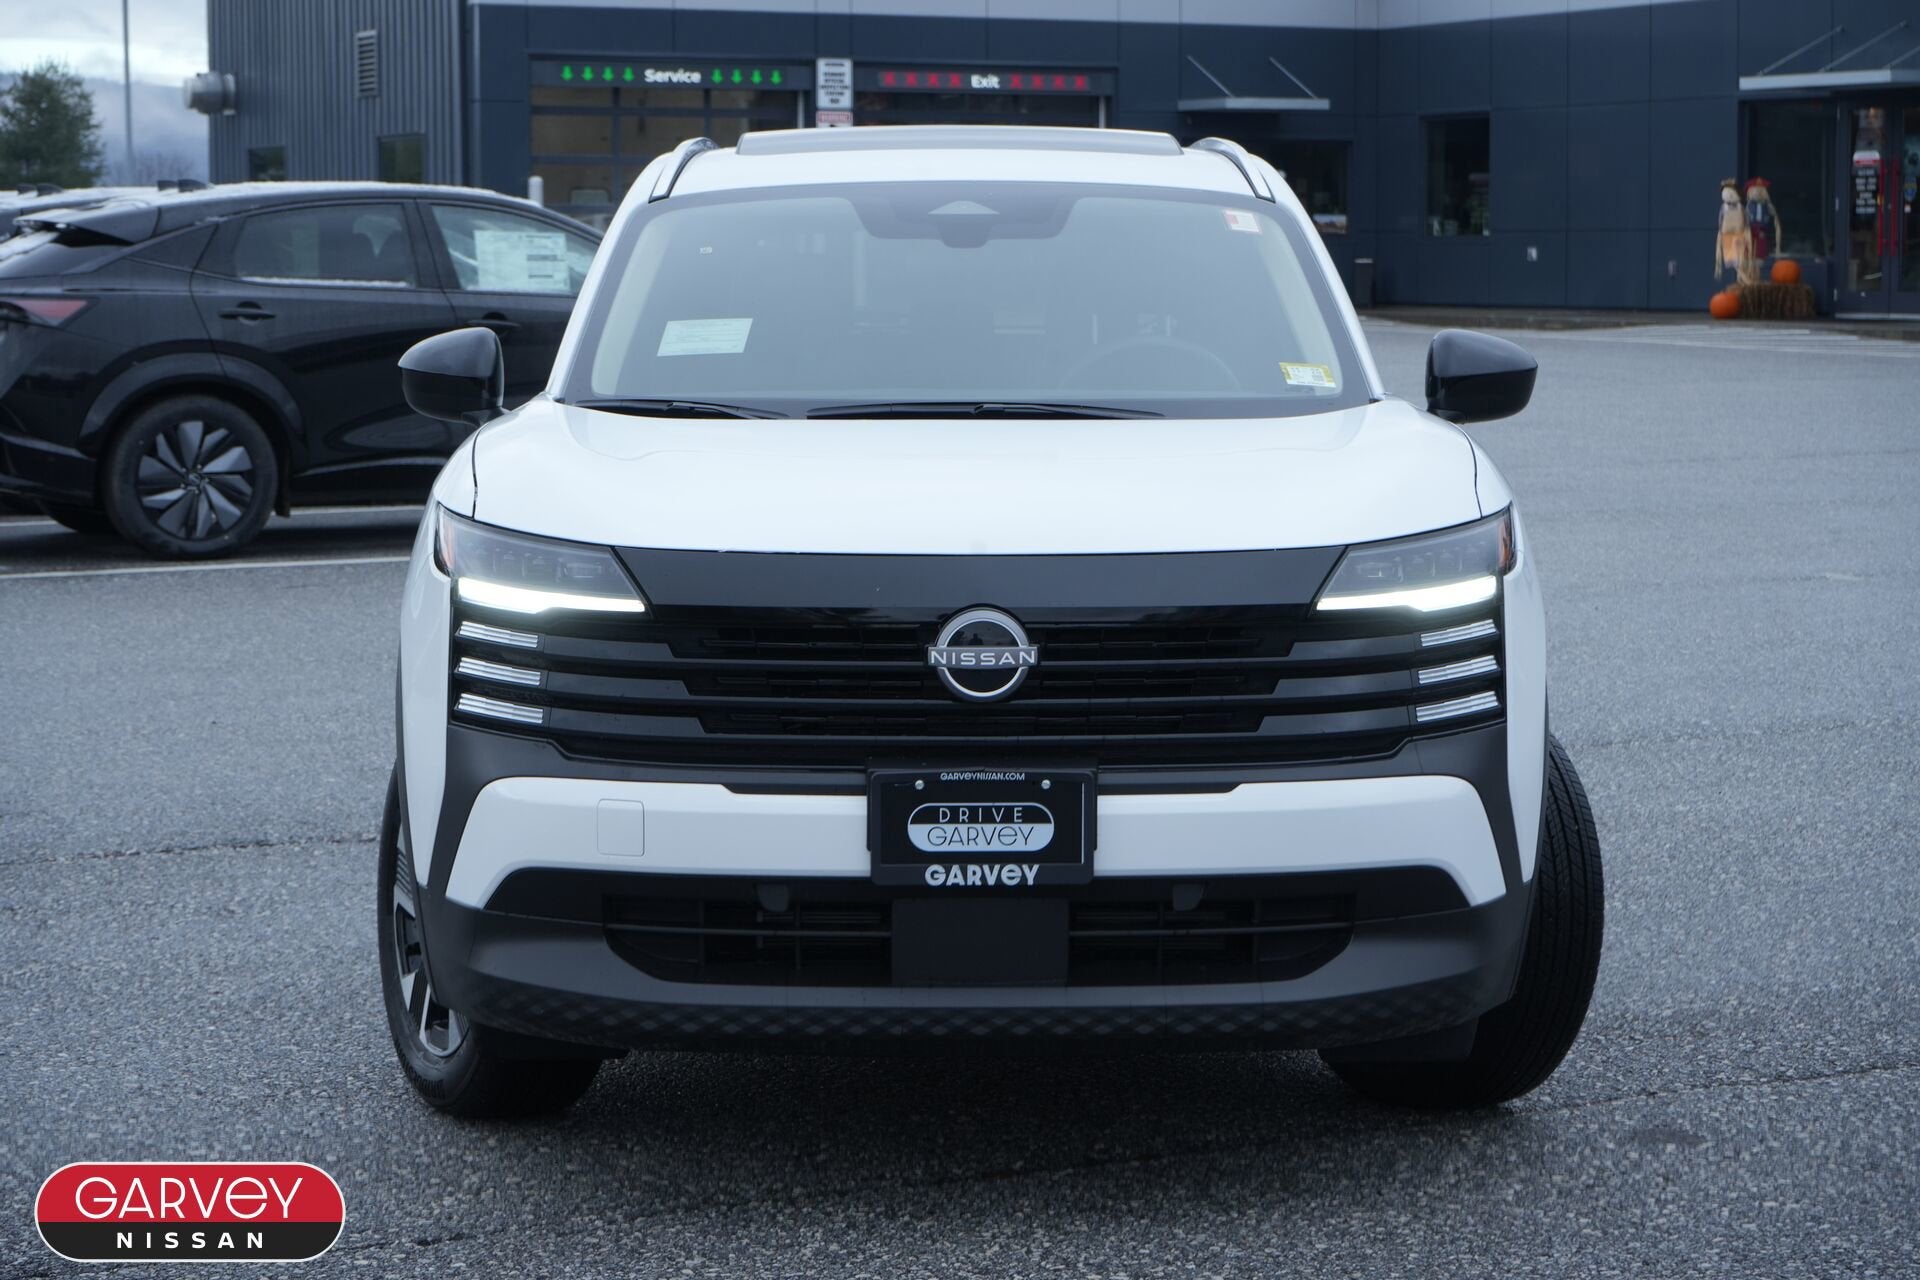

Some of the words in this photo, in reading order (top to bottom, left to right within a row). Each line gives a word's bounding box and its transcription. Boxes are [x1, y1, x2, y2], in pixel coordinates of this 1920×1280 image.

[643, 68, 702, 83] Service
[970, 73, 1001, 88] Exit
[930, 650, 1035, 665] NISSAN
[939, 807, 1023, 823] DRIVE
